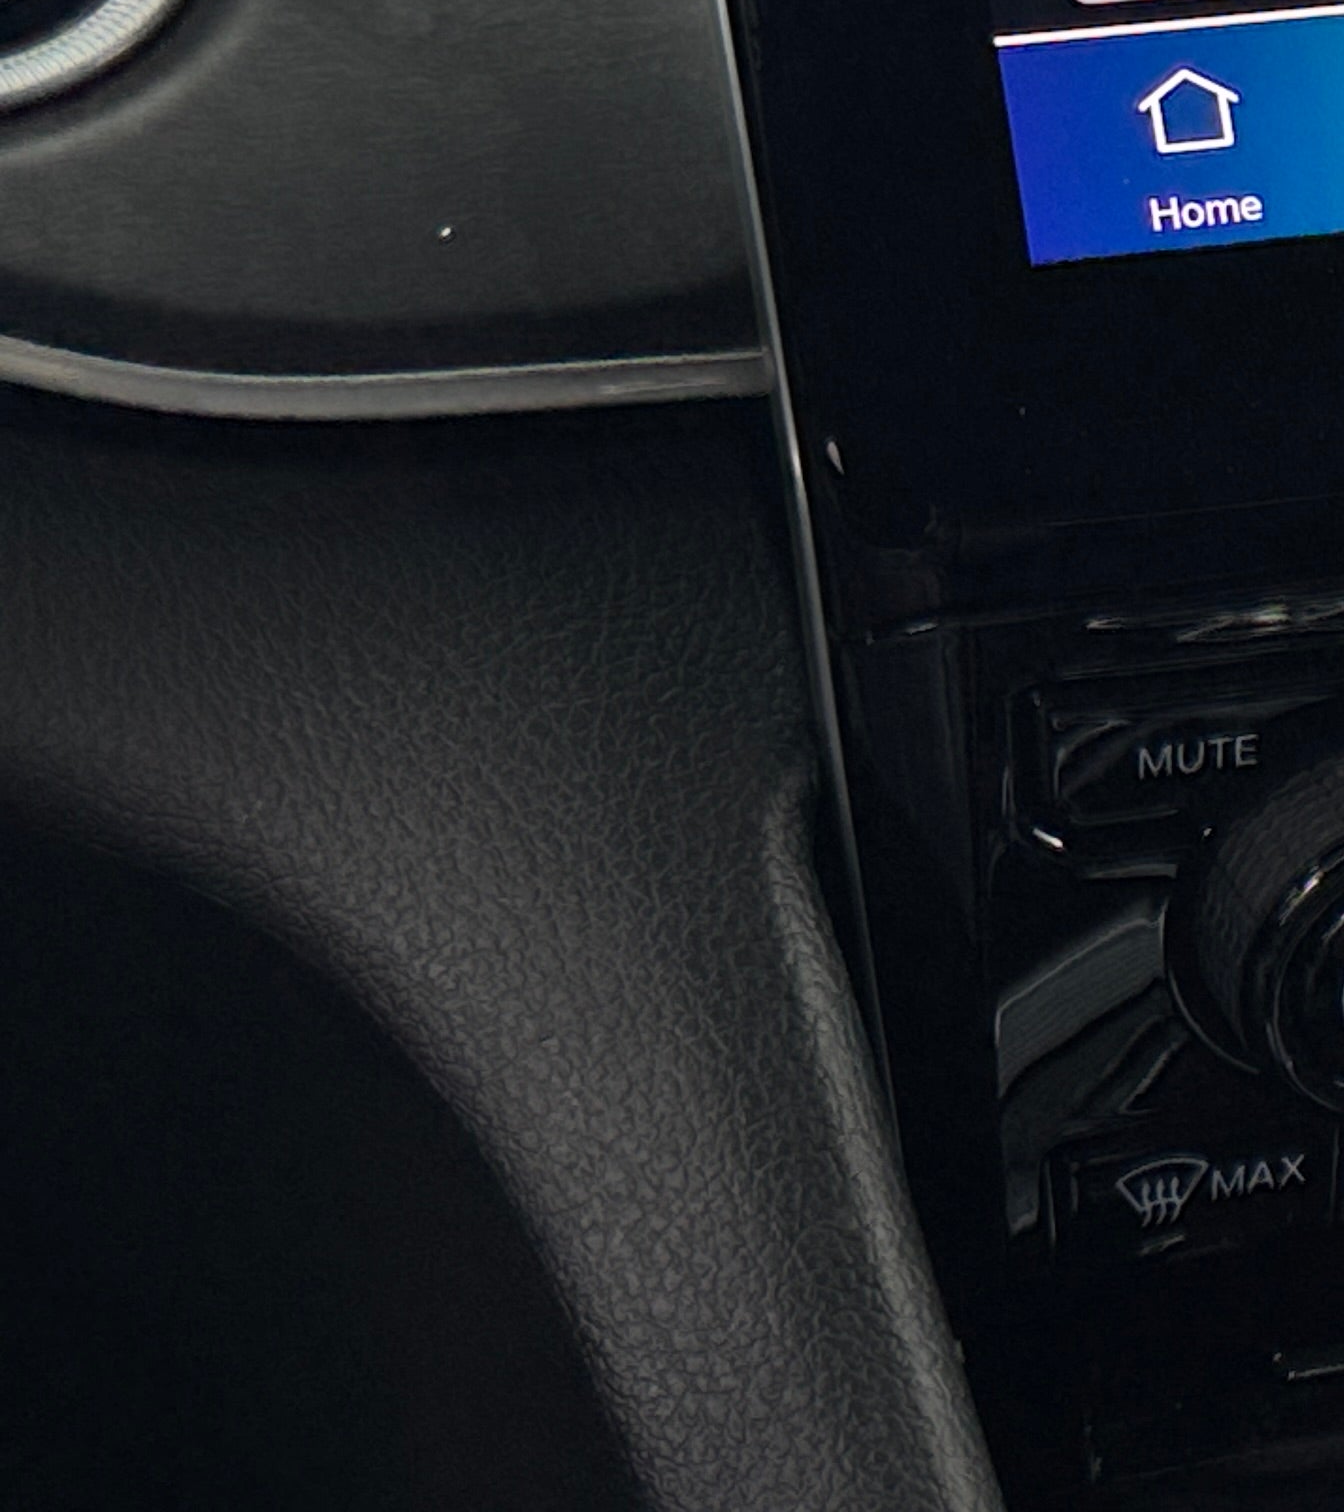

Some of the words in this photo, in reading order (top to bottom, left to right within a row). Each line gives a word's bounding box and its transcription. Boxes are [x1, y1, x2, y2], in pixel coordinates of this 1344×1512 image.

[1149, 193, 1263, 232] Home
[1137, 735, 1260, 780] MUTE
[1211, 1154, 1306, 1202] MAX
